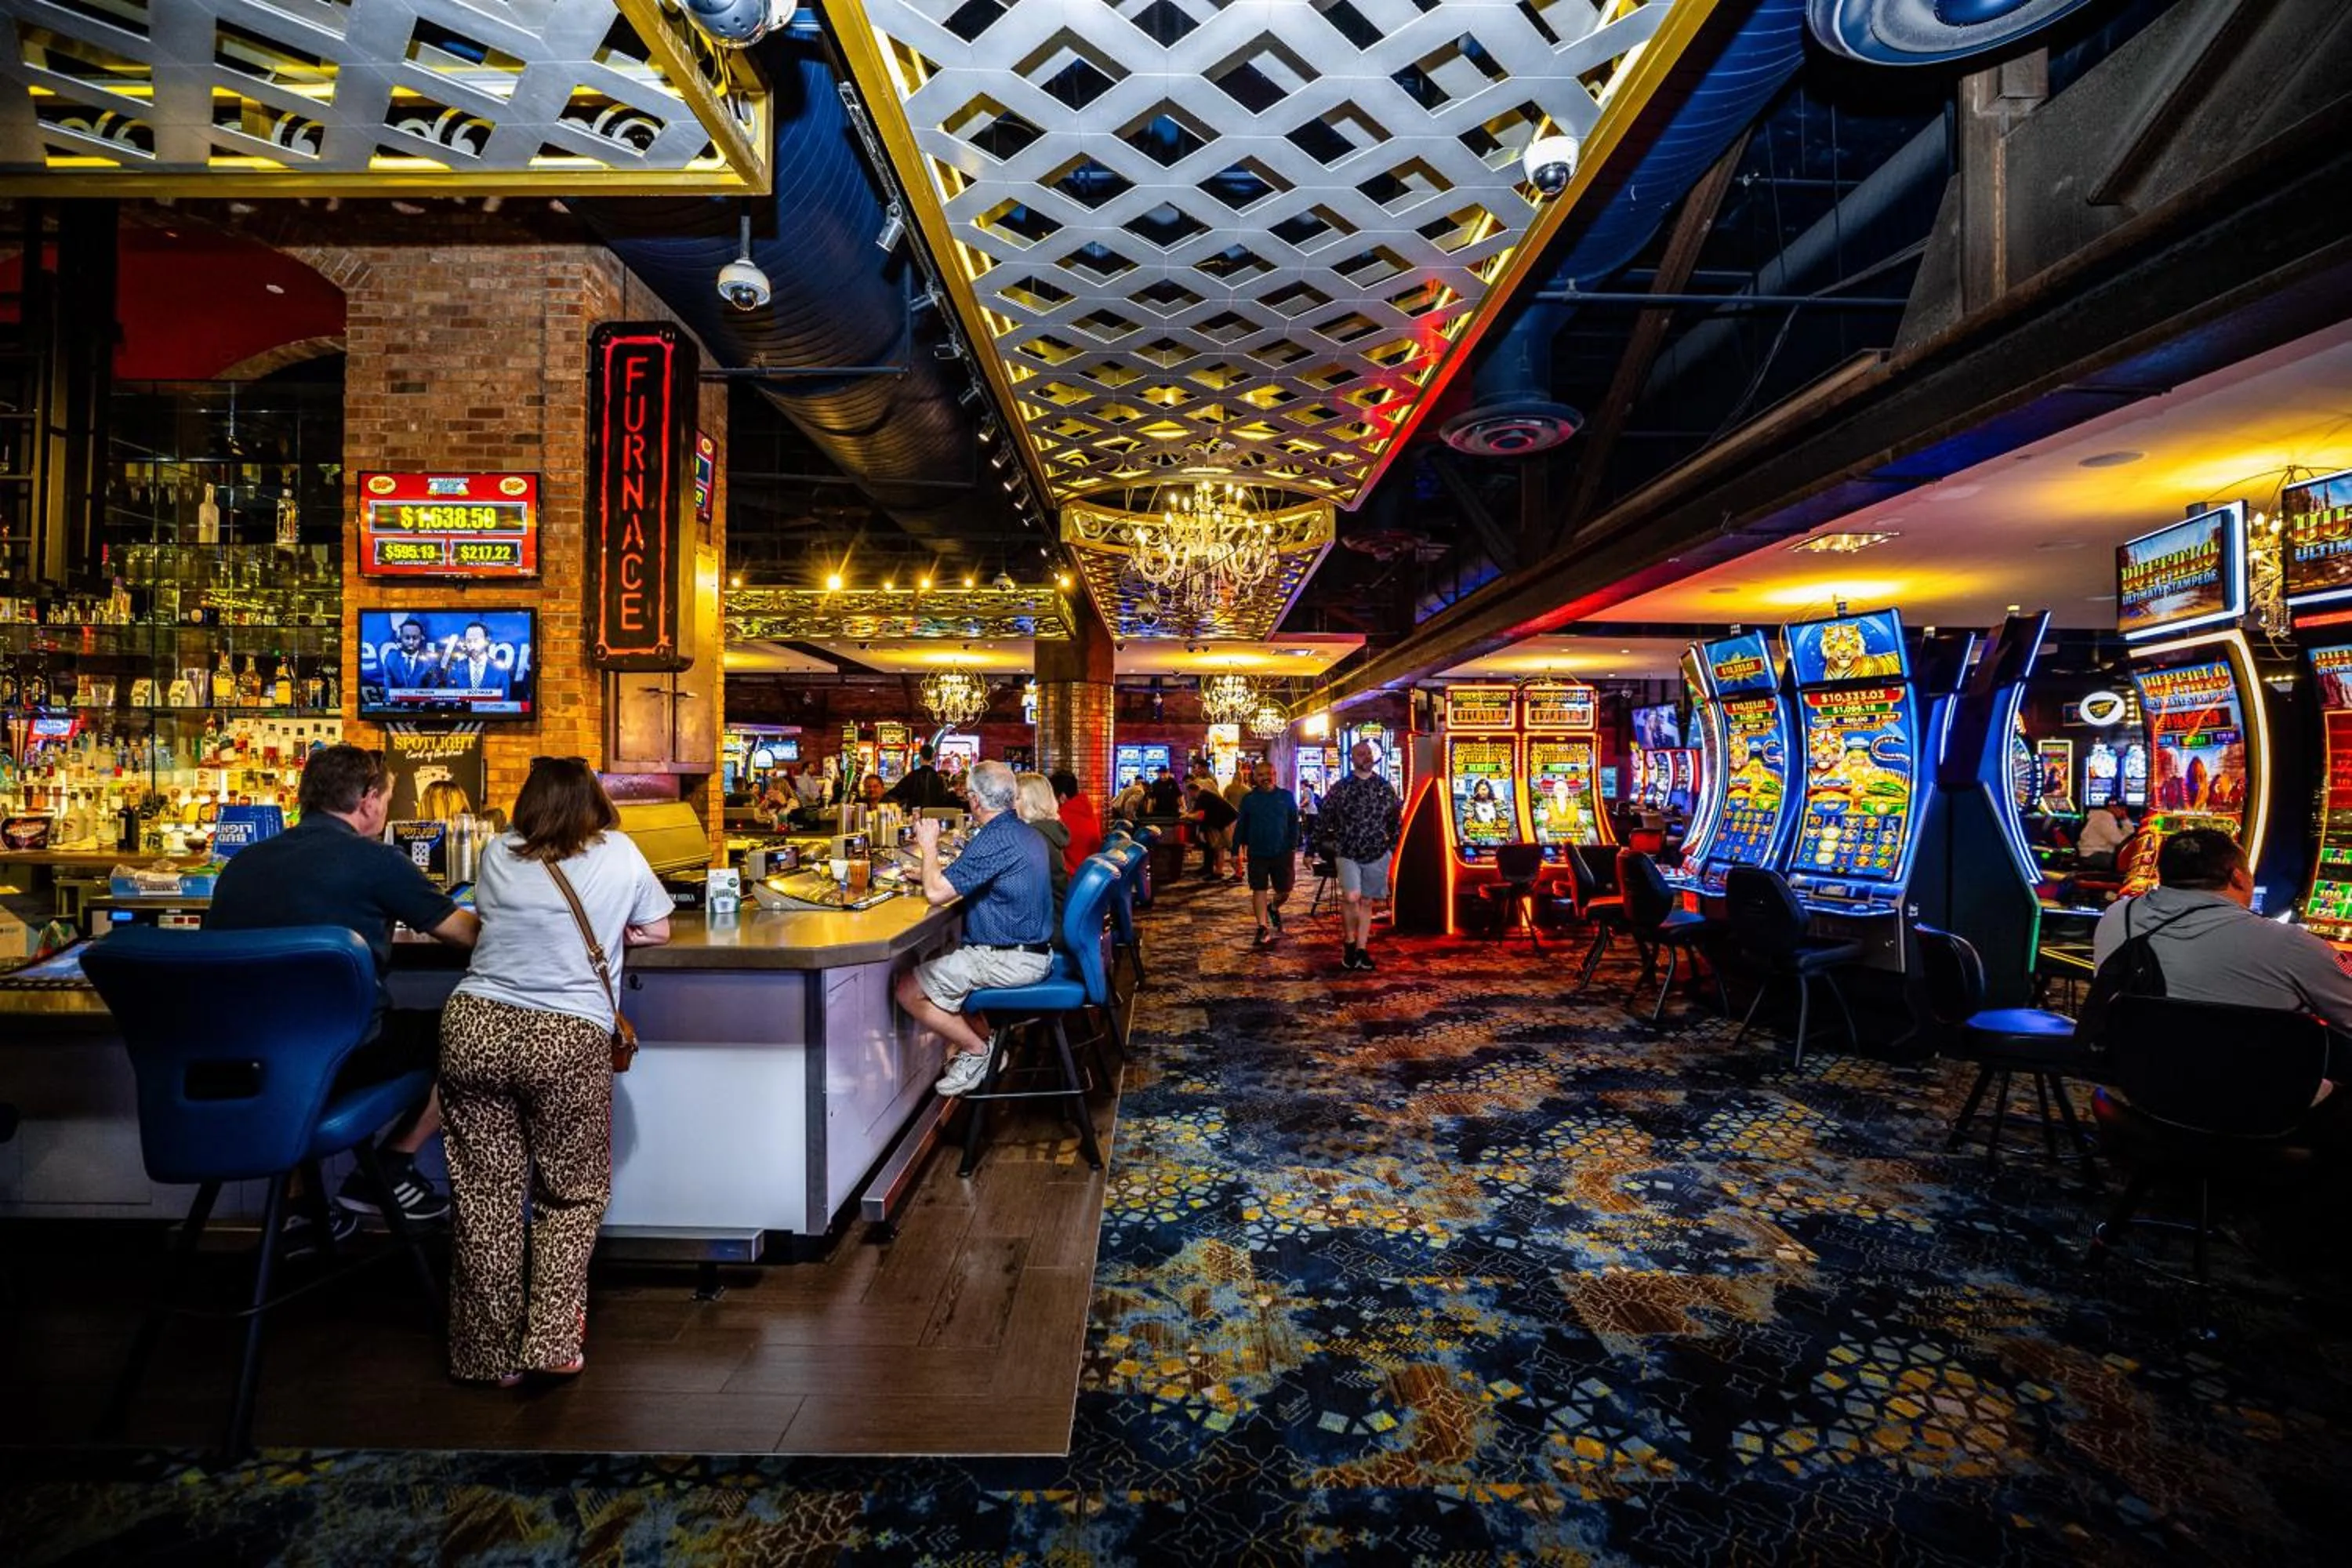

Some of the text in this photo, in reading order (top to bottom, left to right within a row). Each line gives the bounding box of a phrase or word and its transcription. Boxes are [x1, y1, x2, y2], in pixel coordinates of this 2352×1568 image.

[621, 357, 649, 630] FURNACE
[2293, 506, 2352, 547] BU
[385, 544, 435, 559] $595.13
[460, 545, 510, 561] $217.22
[394, 735, 476, 750] SPOTLIGHT
[219, 833, 247, 843] BUD
